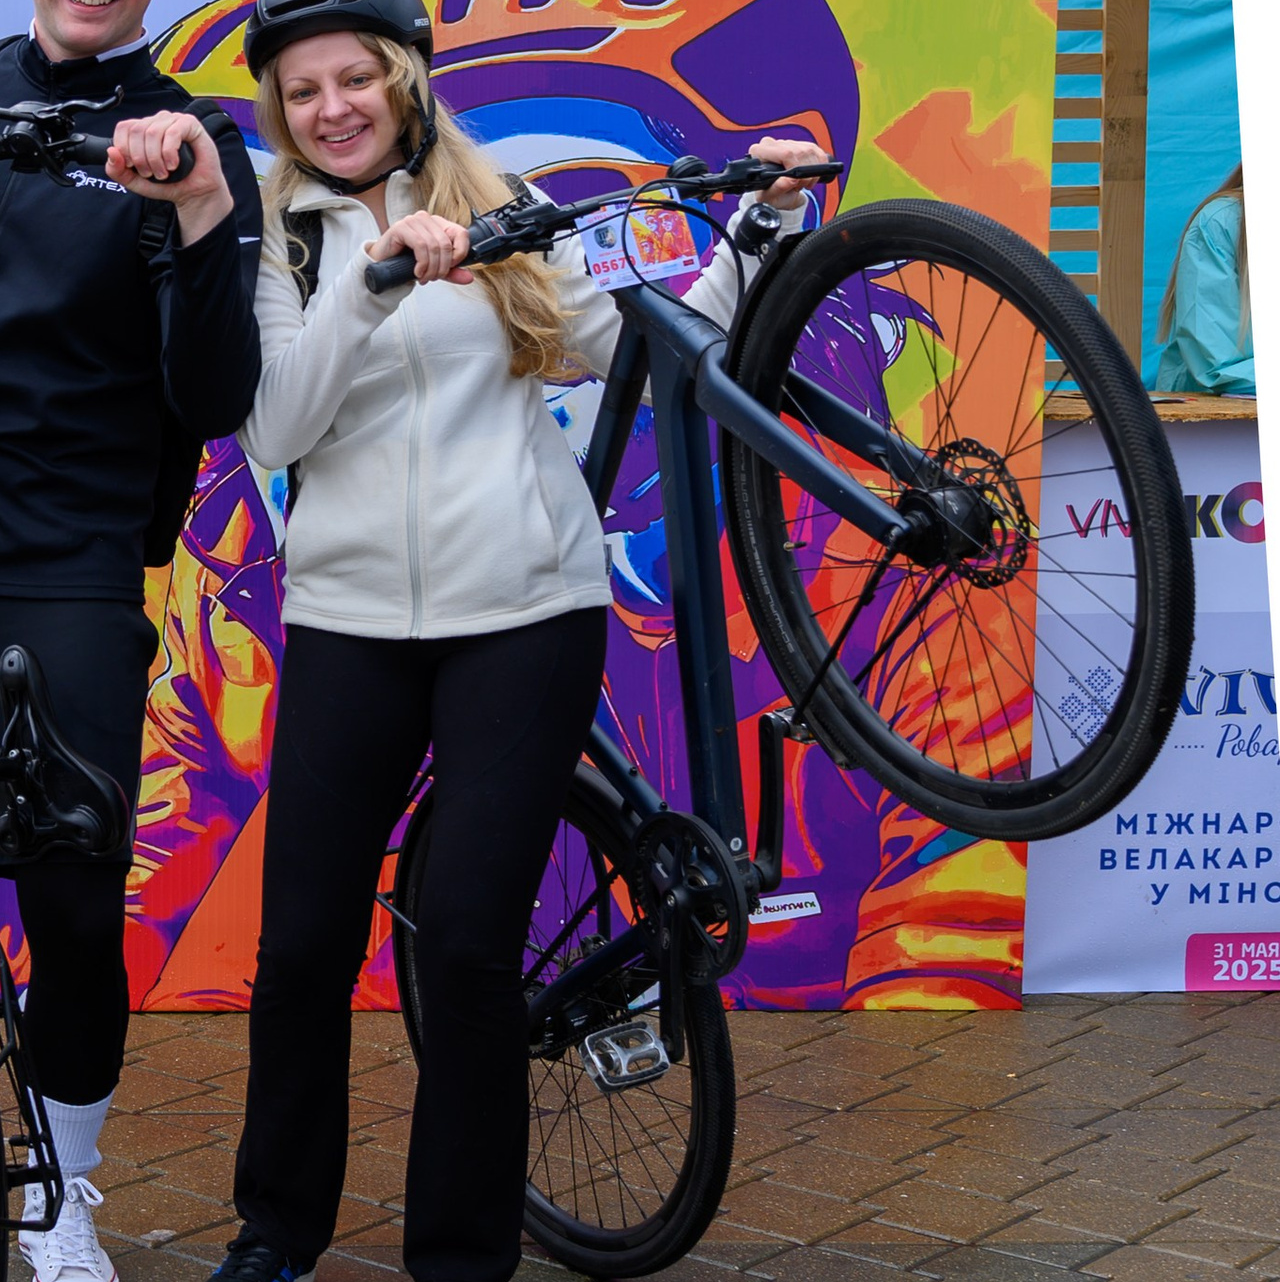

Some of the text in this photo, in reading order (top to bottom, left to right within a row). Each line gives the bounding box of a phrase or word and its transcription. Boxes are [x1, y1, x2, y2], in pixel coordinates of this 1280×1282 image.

[1116, 812, 1280, 835] МІЖНАР
[1100, 847, 1273, 870] ВЕЛАКАР
[1150, 883, 1170, 905] У
[1213, 942, 1280, 958] 31 МАЯ
